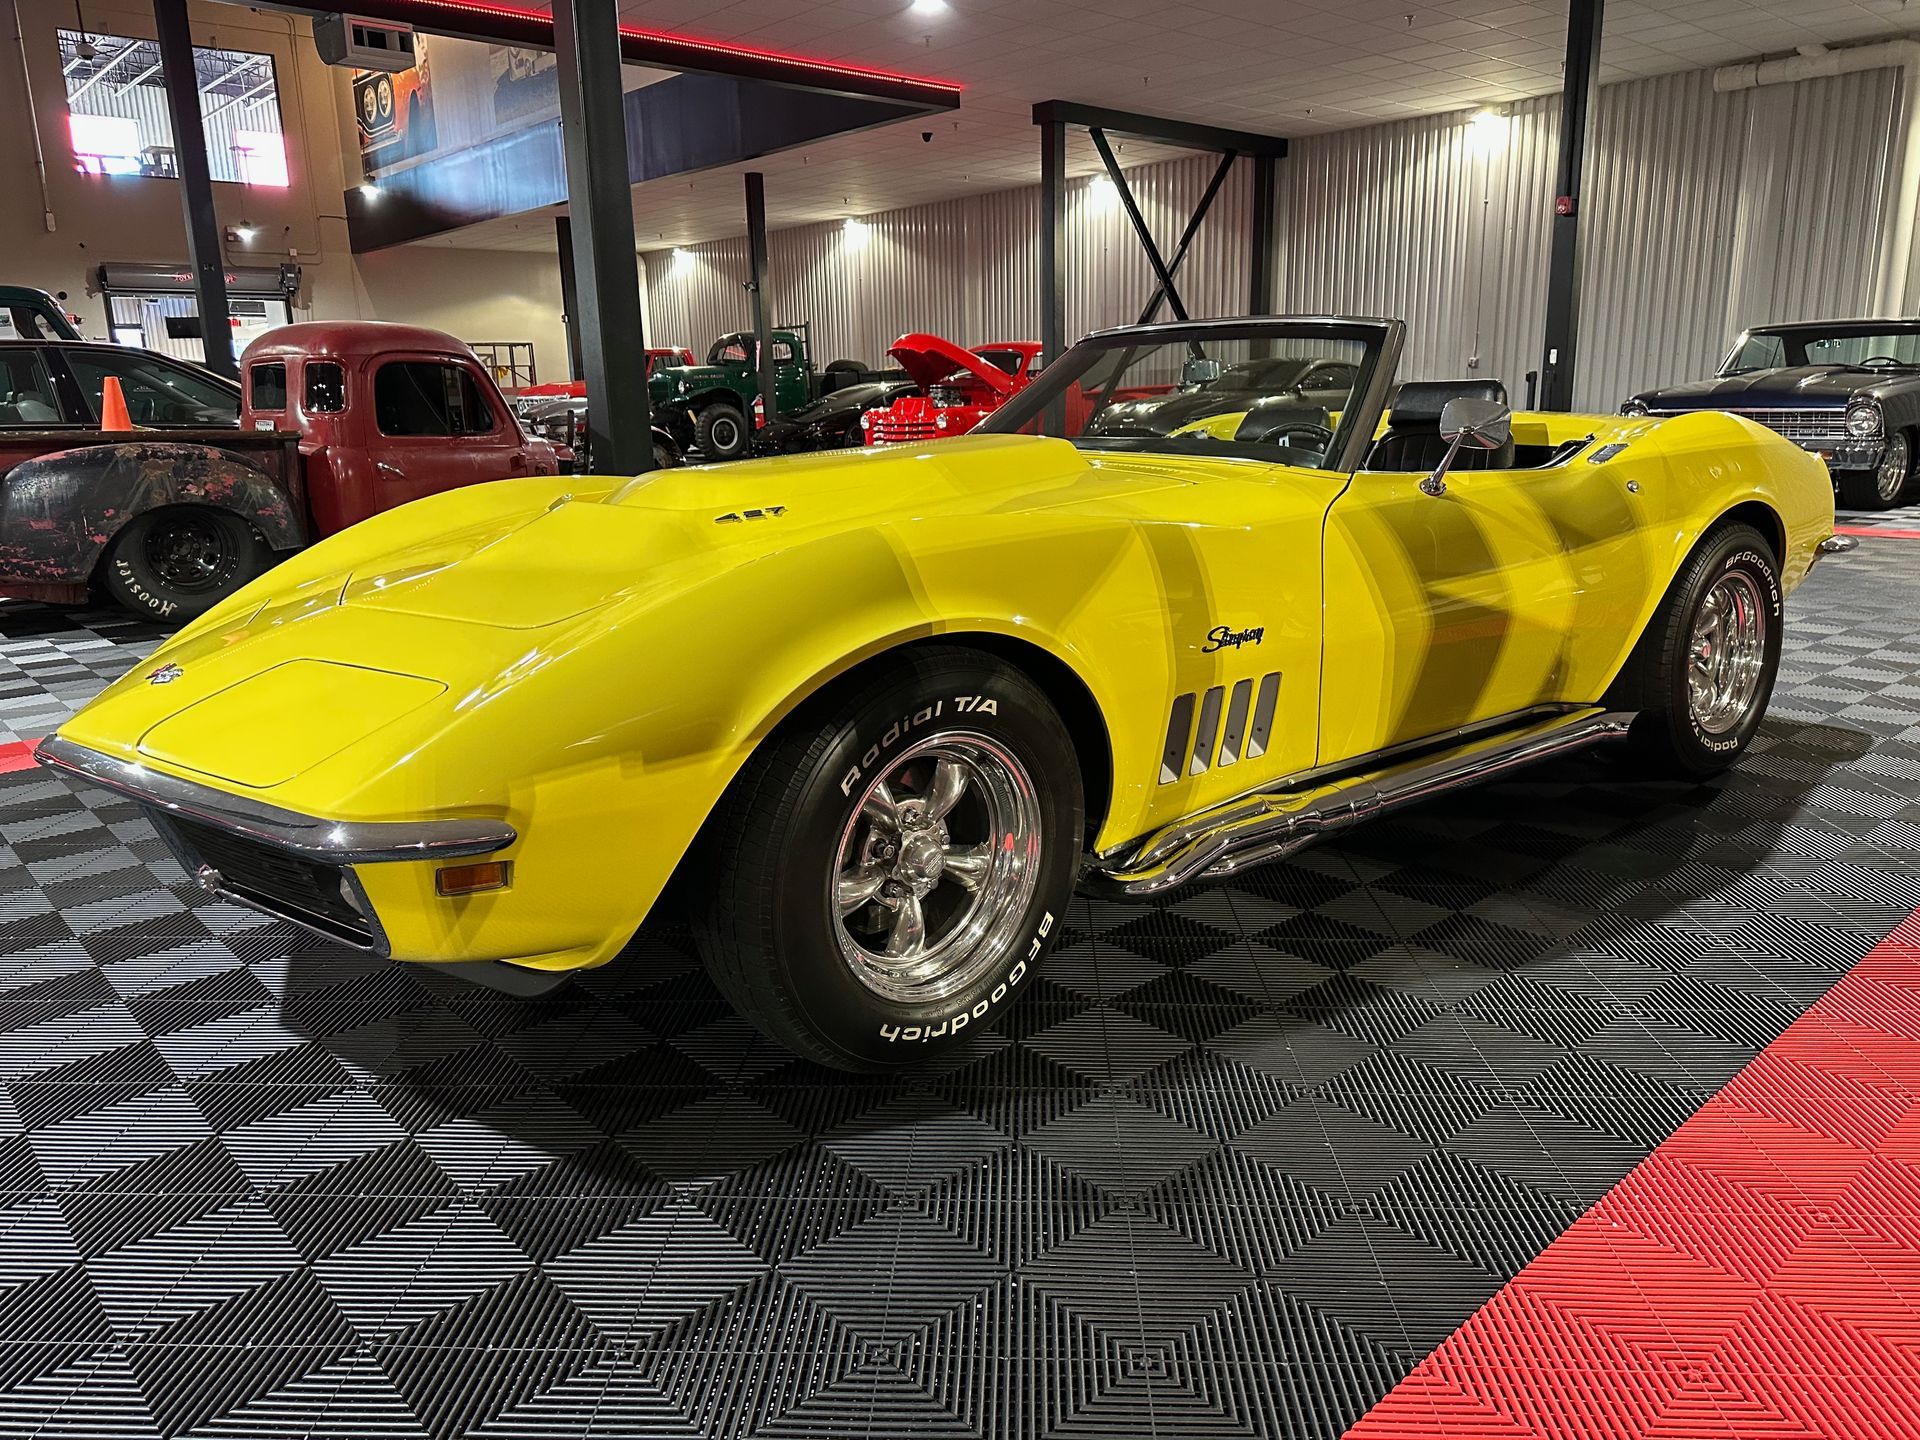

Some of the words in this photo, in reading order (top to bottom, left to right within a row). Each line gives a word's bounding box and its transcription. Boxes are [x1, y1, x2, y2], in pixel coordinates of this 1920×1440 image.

[714, 505, 789, 523] 427
[116, 559, 178, 617] Hoosier
[1725, 551, 1780, 616] BFGoodrich
[1201, 625, 1265, 653] Stingray
[841, 700, 943, 797] Radial
[954, 695, 998, 716] T/A
[1699, 736, 1739, 753] Radial
[879, 911, 1054, 1043] BFGoodrich
